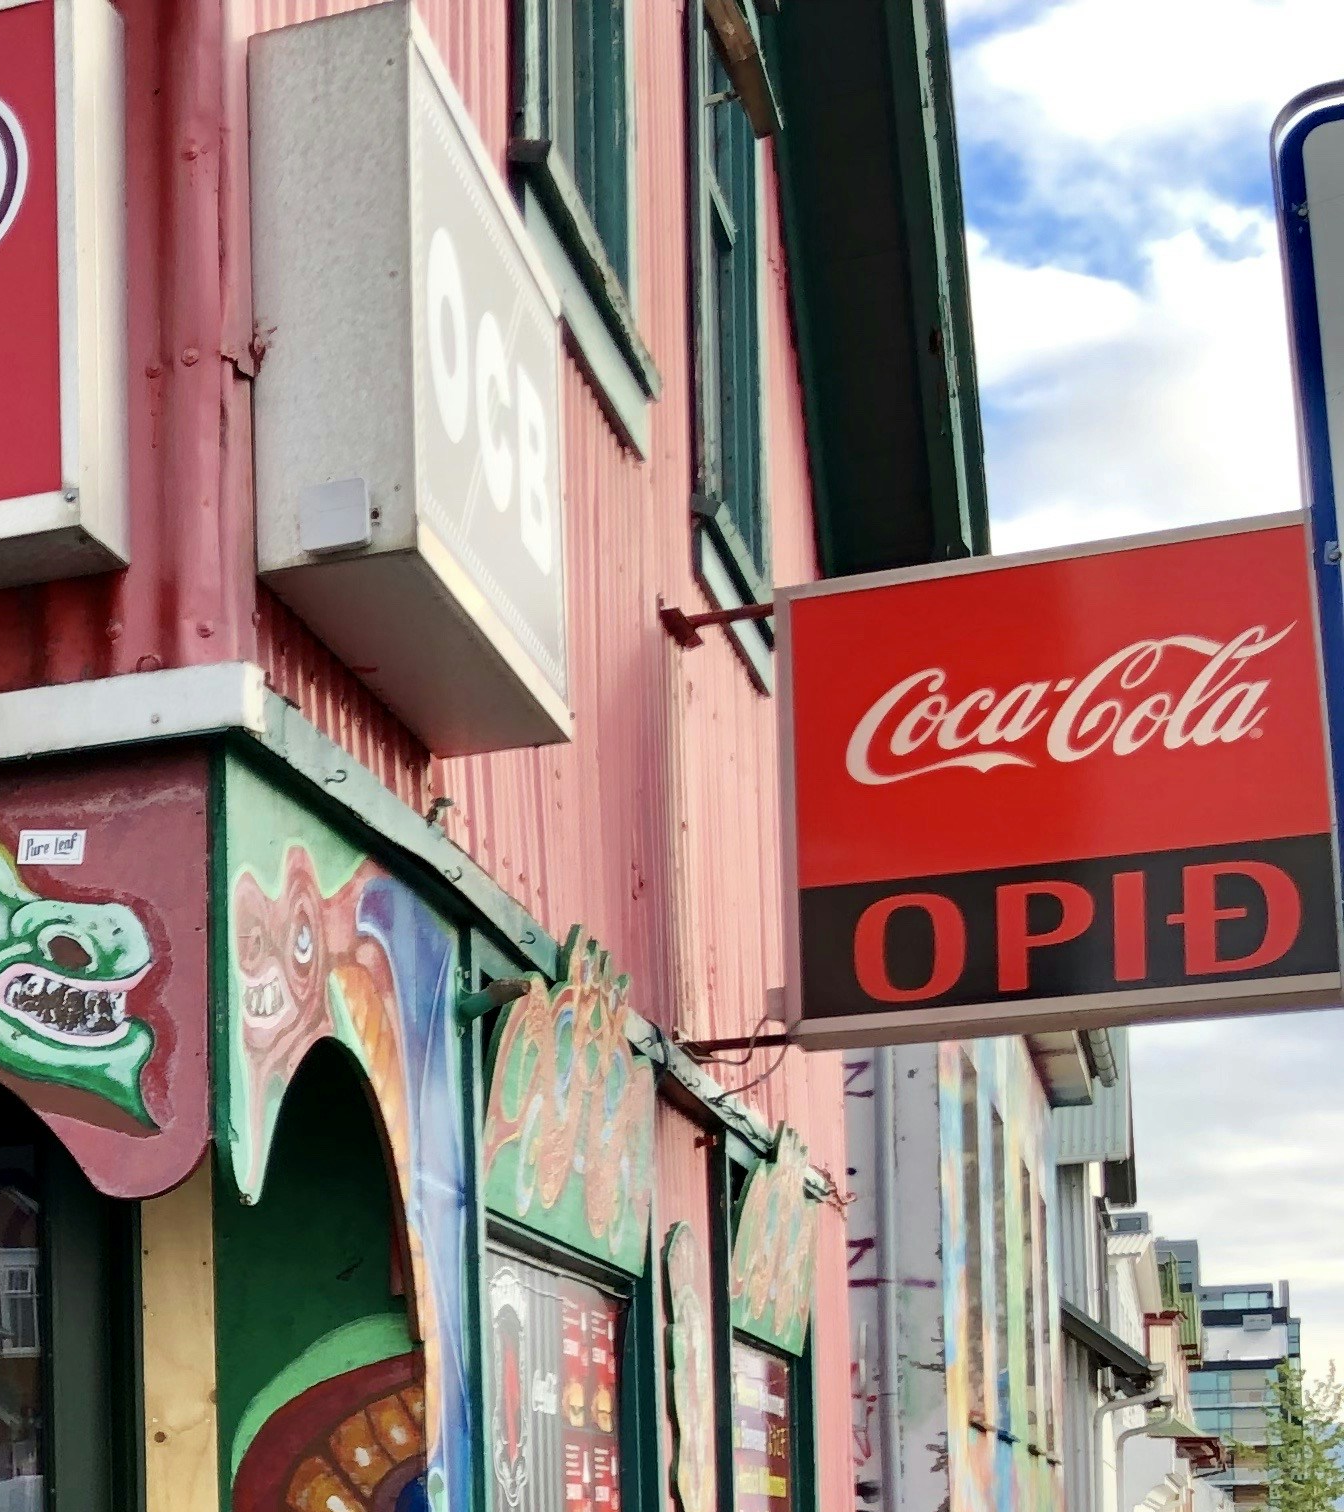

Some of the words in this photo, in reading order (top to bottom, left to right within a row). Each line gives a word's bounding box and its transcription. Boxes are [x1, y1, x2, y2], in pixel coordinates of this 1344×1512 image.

[427, 227, 552, 576] OCB
[846, 619, 1297, 785] Coca-Cola
[25, 838, 50, 861] Pure
[54, 832, 78, 855] Leaf
